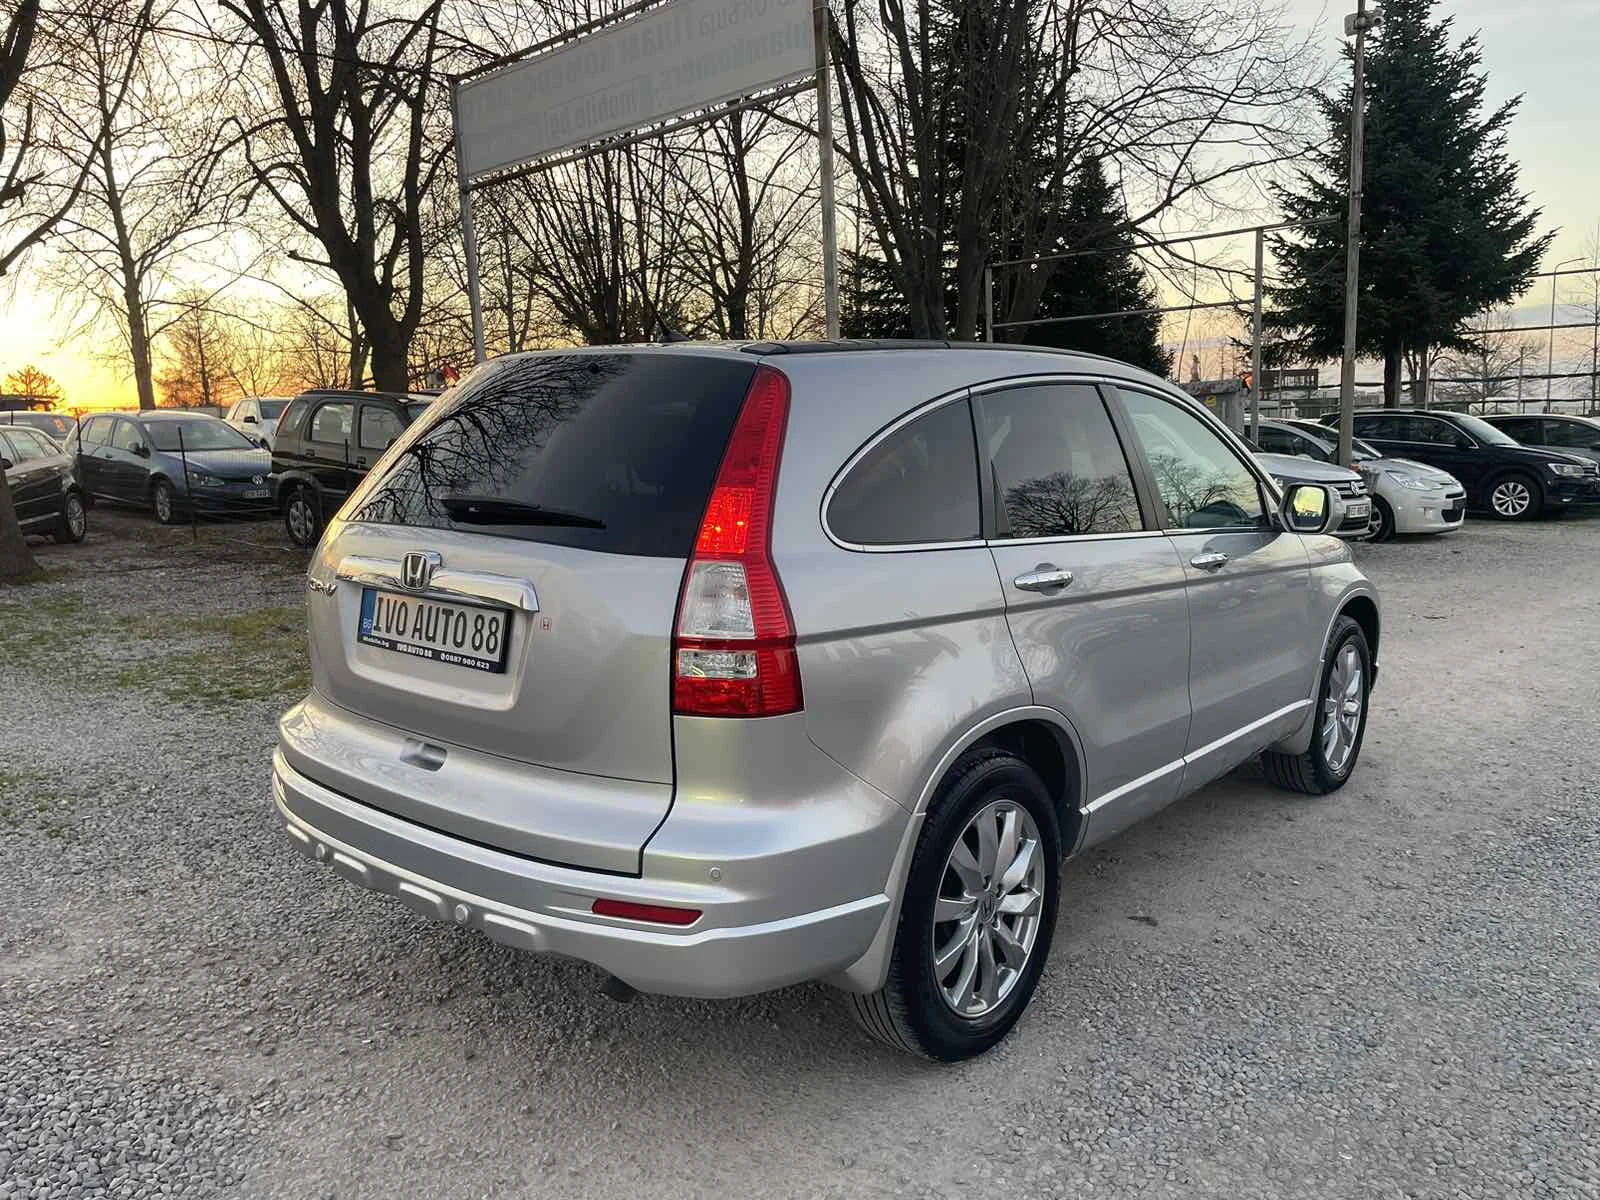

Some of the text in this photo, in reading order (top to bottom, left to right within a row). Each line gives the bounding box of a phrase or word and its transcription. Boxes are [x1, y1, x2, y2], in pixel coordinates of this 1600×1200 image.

[373, 597, 499, 654] IVO AUTO 88
